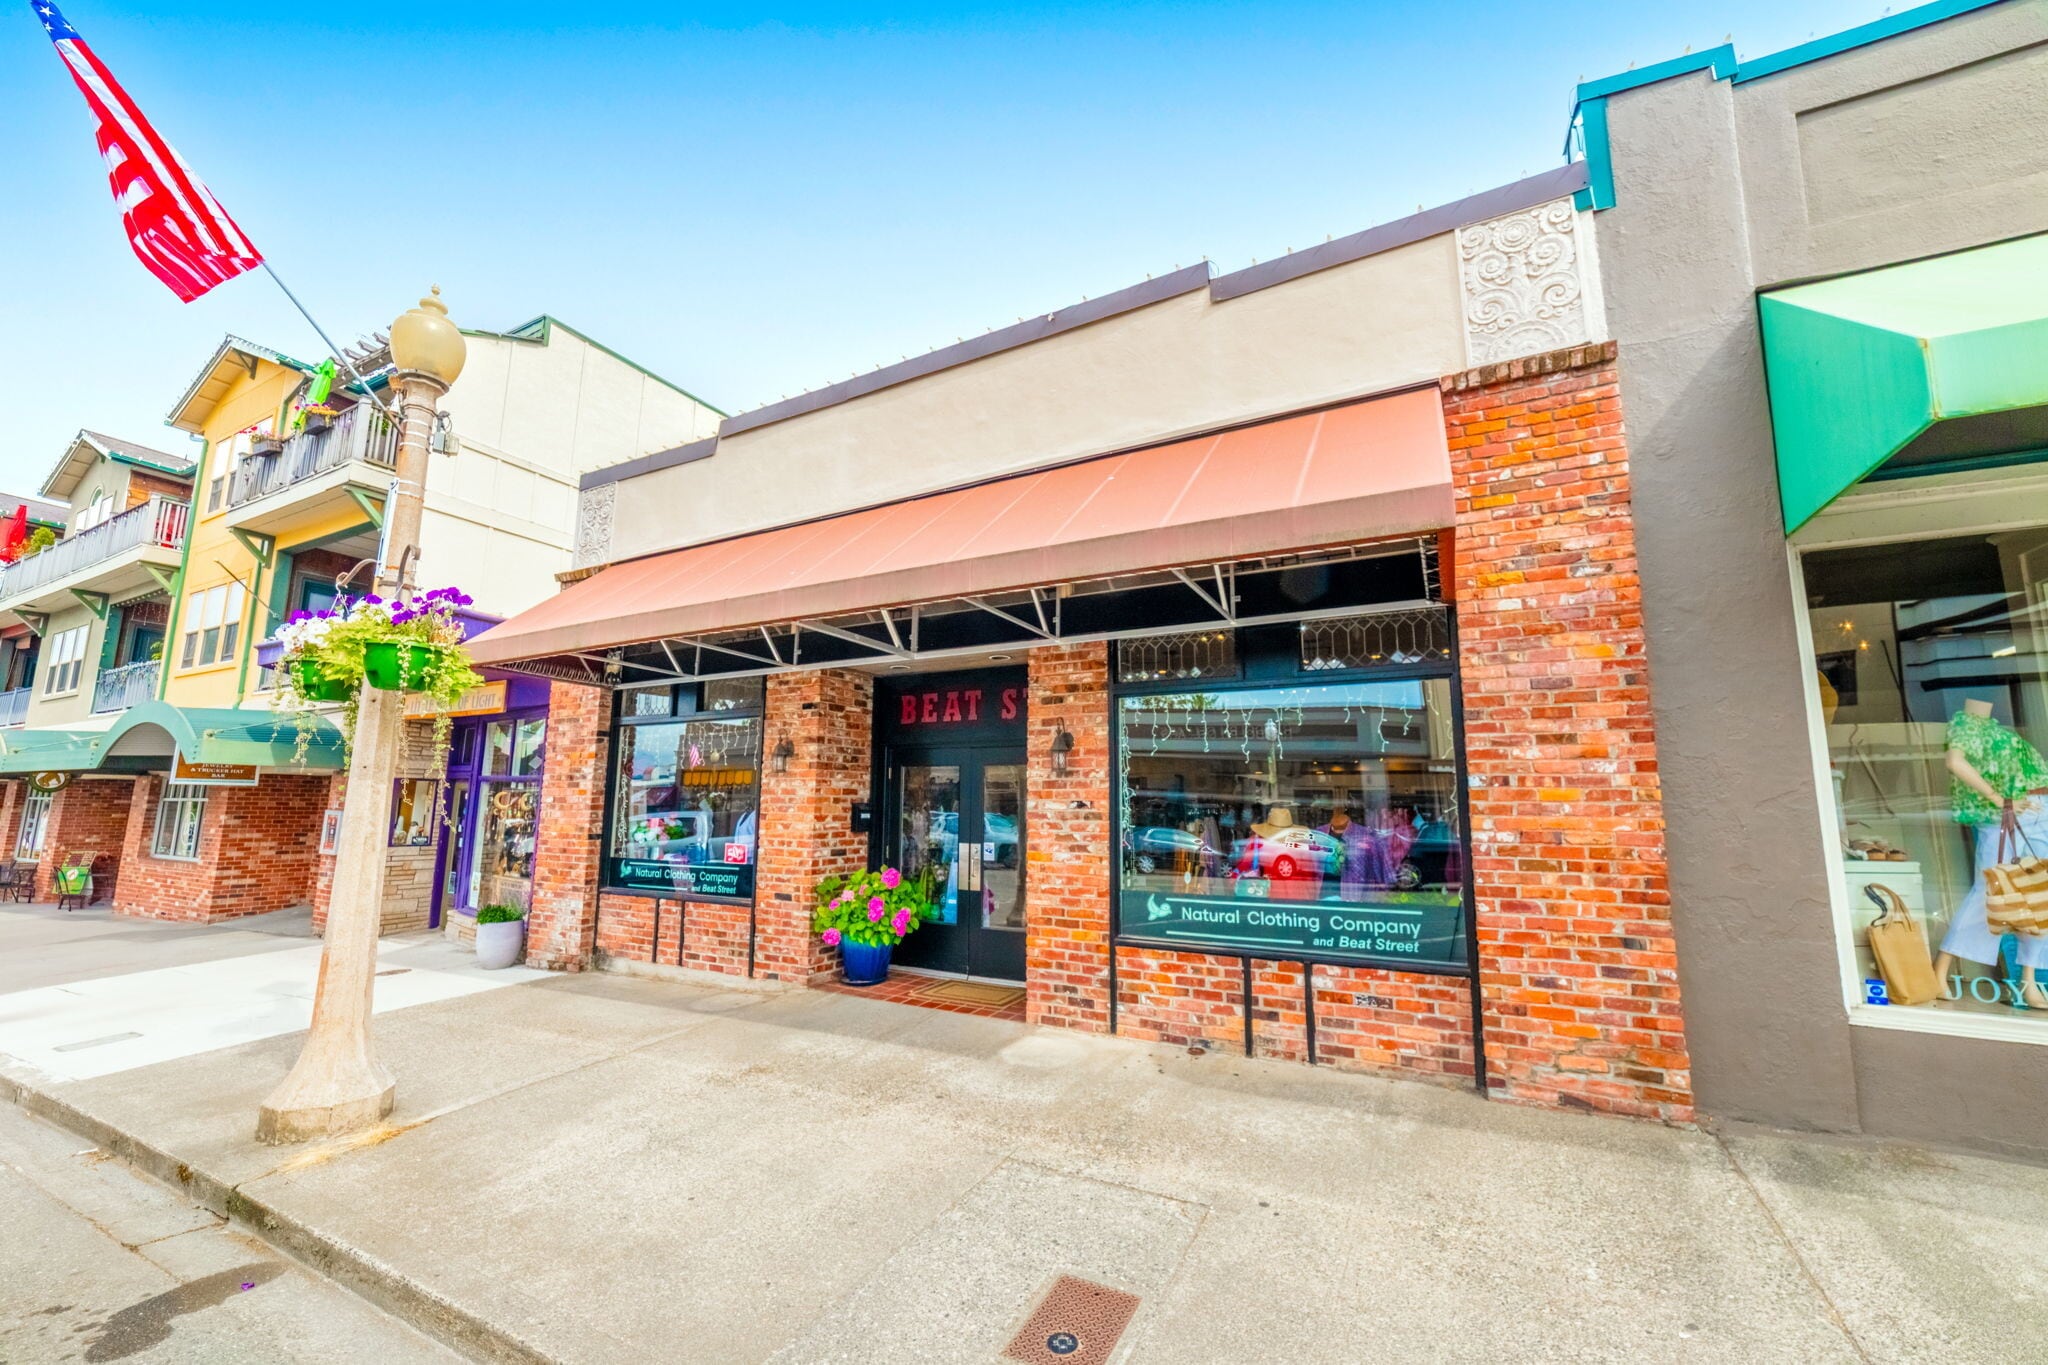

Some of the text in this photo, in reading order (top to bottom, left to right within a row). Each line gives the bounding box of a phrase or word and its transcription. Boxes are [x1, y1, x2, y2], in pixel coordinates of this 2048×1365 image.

[472, 693, 497, 709] LIGHT
[900, 687, 1028, 725] BEAT S
[635, 867, 738, 885] Natural Clothing Company
[691, 884, 737, 895] and Beat Street
[1181, 906, 1421, 938] Natural Clothing Company
[1313, 936, 1420, 953] and Beat Street
